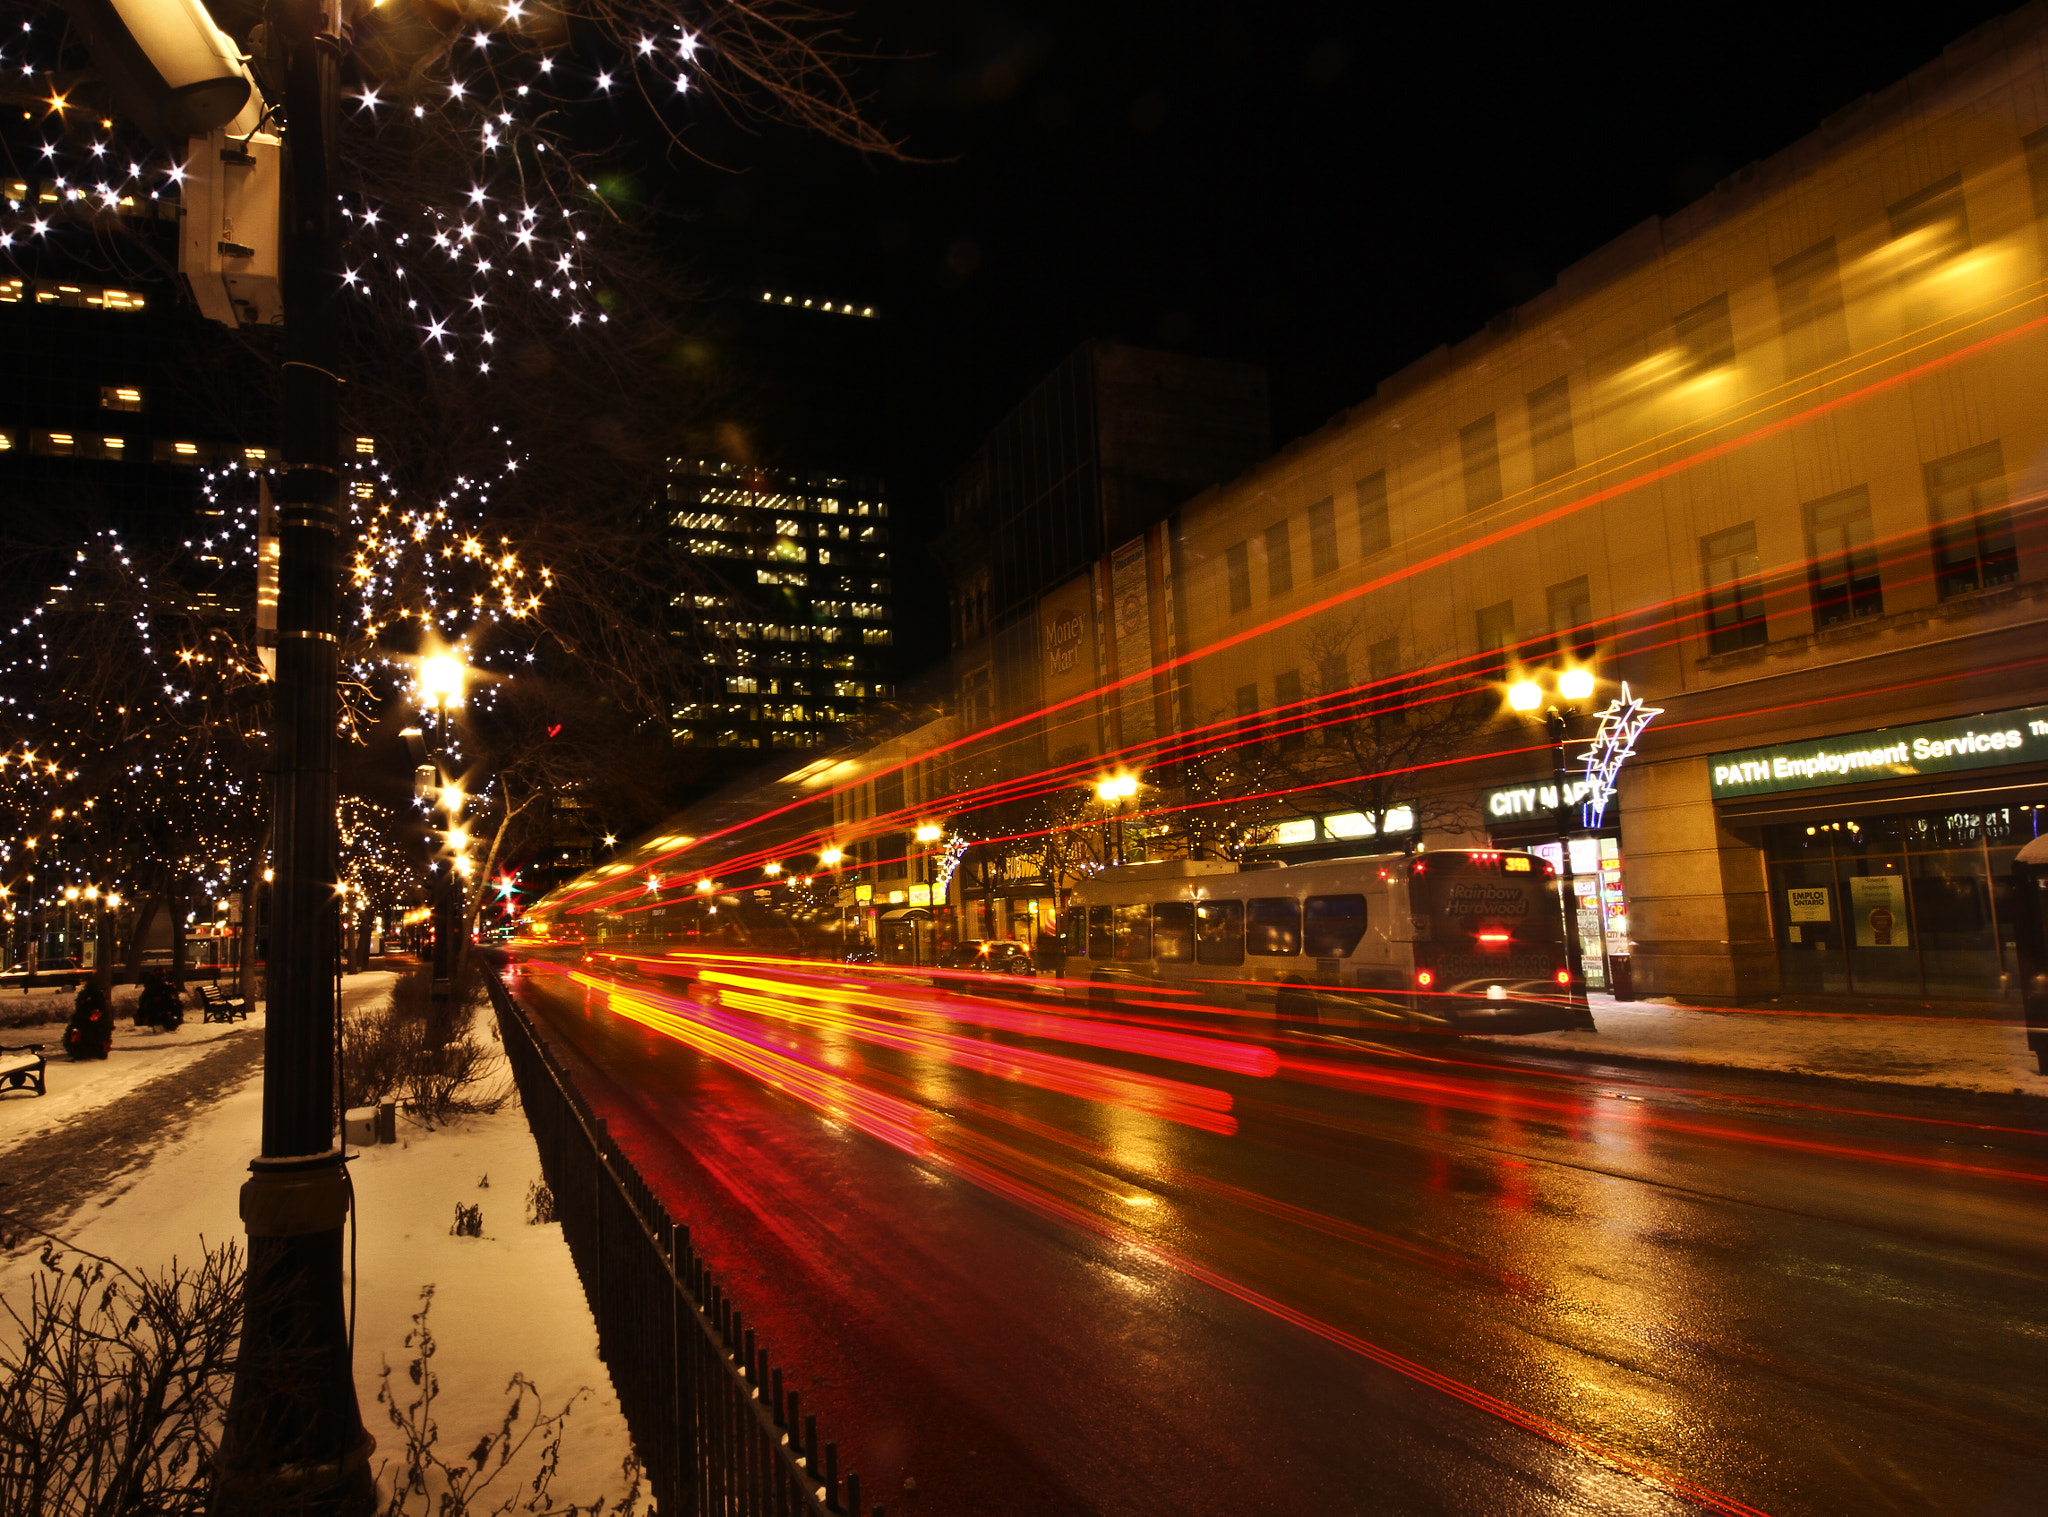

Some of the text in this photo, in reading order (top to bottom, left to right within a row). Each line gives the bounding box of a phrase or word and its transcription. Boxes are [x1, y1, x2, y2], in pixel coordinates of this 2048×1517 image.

[1046, 612, 1088, 651] Money
[1050, 644, 1081, 676] Mart
[1715, 760, 1770, 786] PATH
[1773, 742, 1909, 778] Employment
[1913, 729, 2023, 760] Services
[1490, 788, 1536, 816] CITY
[1454, 884, 1520, 899] Rainbow
[1792, 891, 1824, 900] EMPLOI
[1448, 900, 1527, 915] Hardwood
